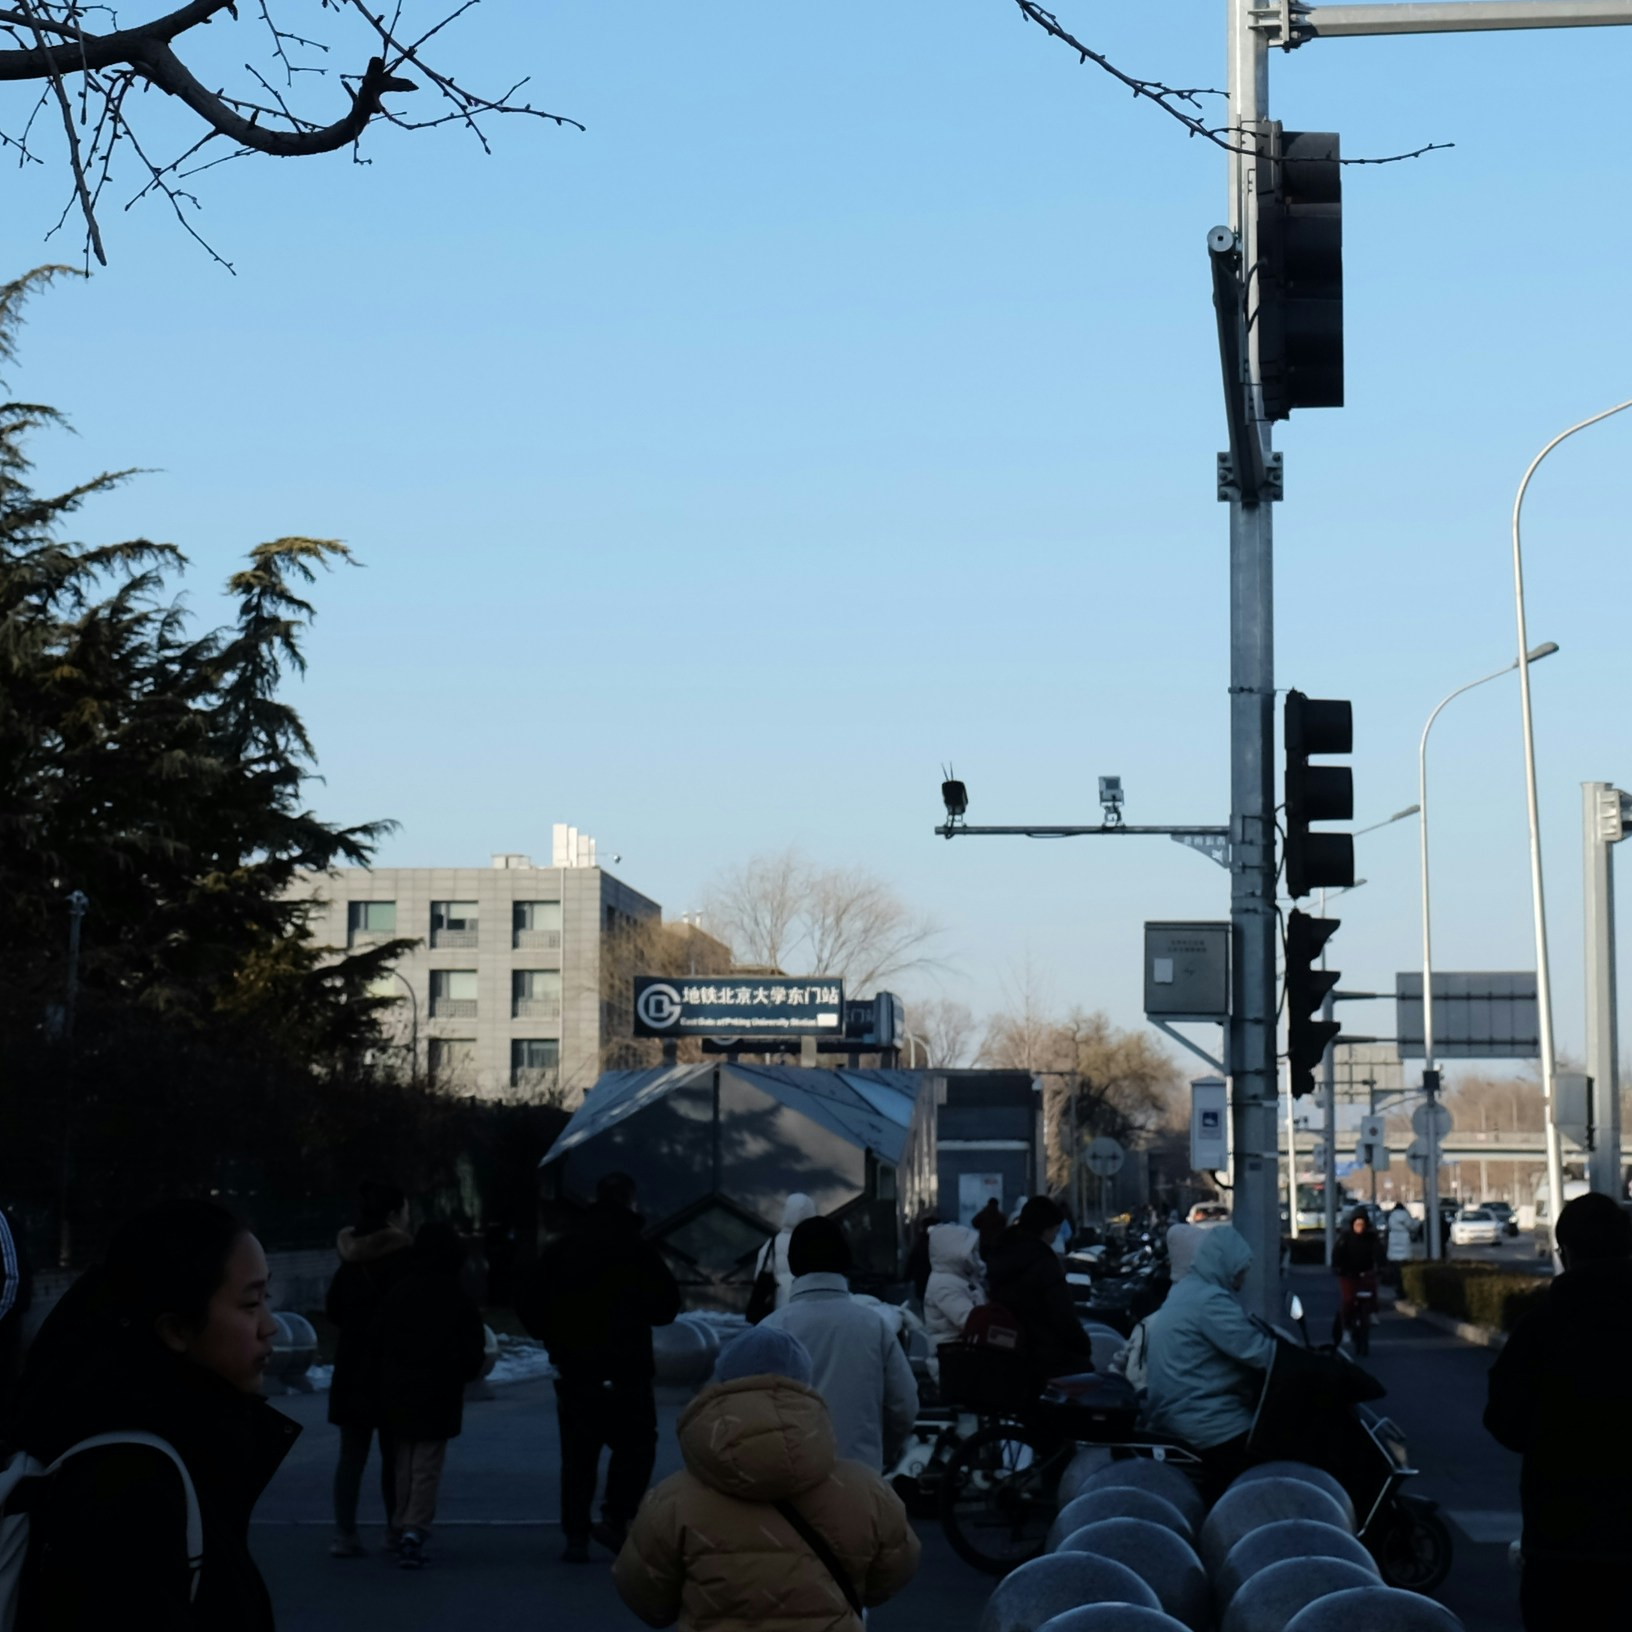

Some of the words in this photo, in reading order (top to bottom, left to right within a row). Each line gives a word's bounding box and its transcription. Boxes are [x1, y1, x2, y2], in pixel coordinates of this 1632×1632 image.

[682, 985, 839, 1006] 地铁北京大学东门站
